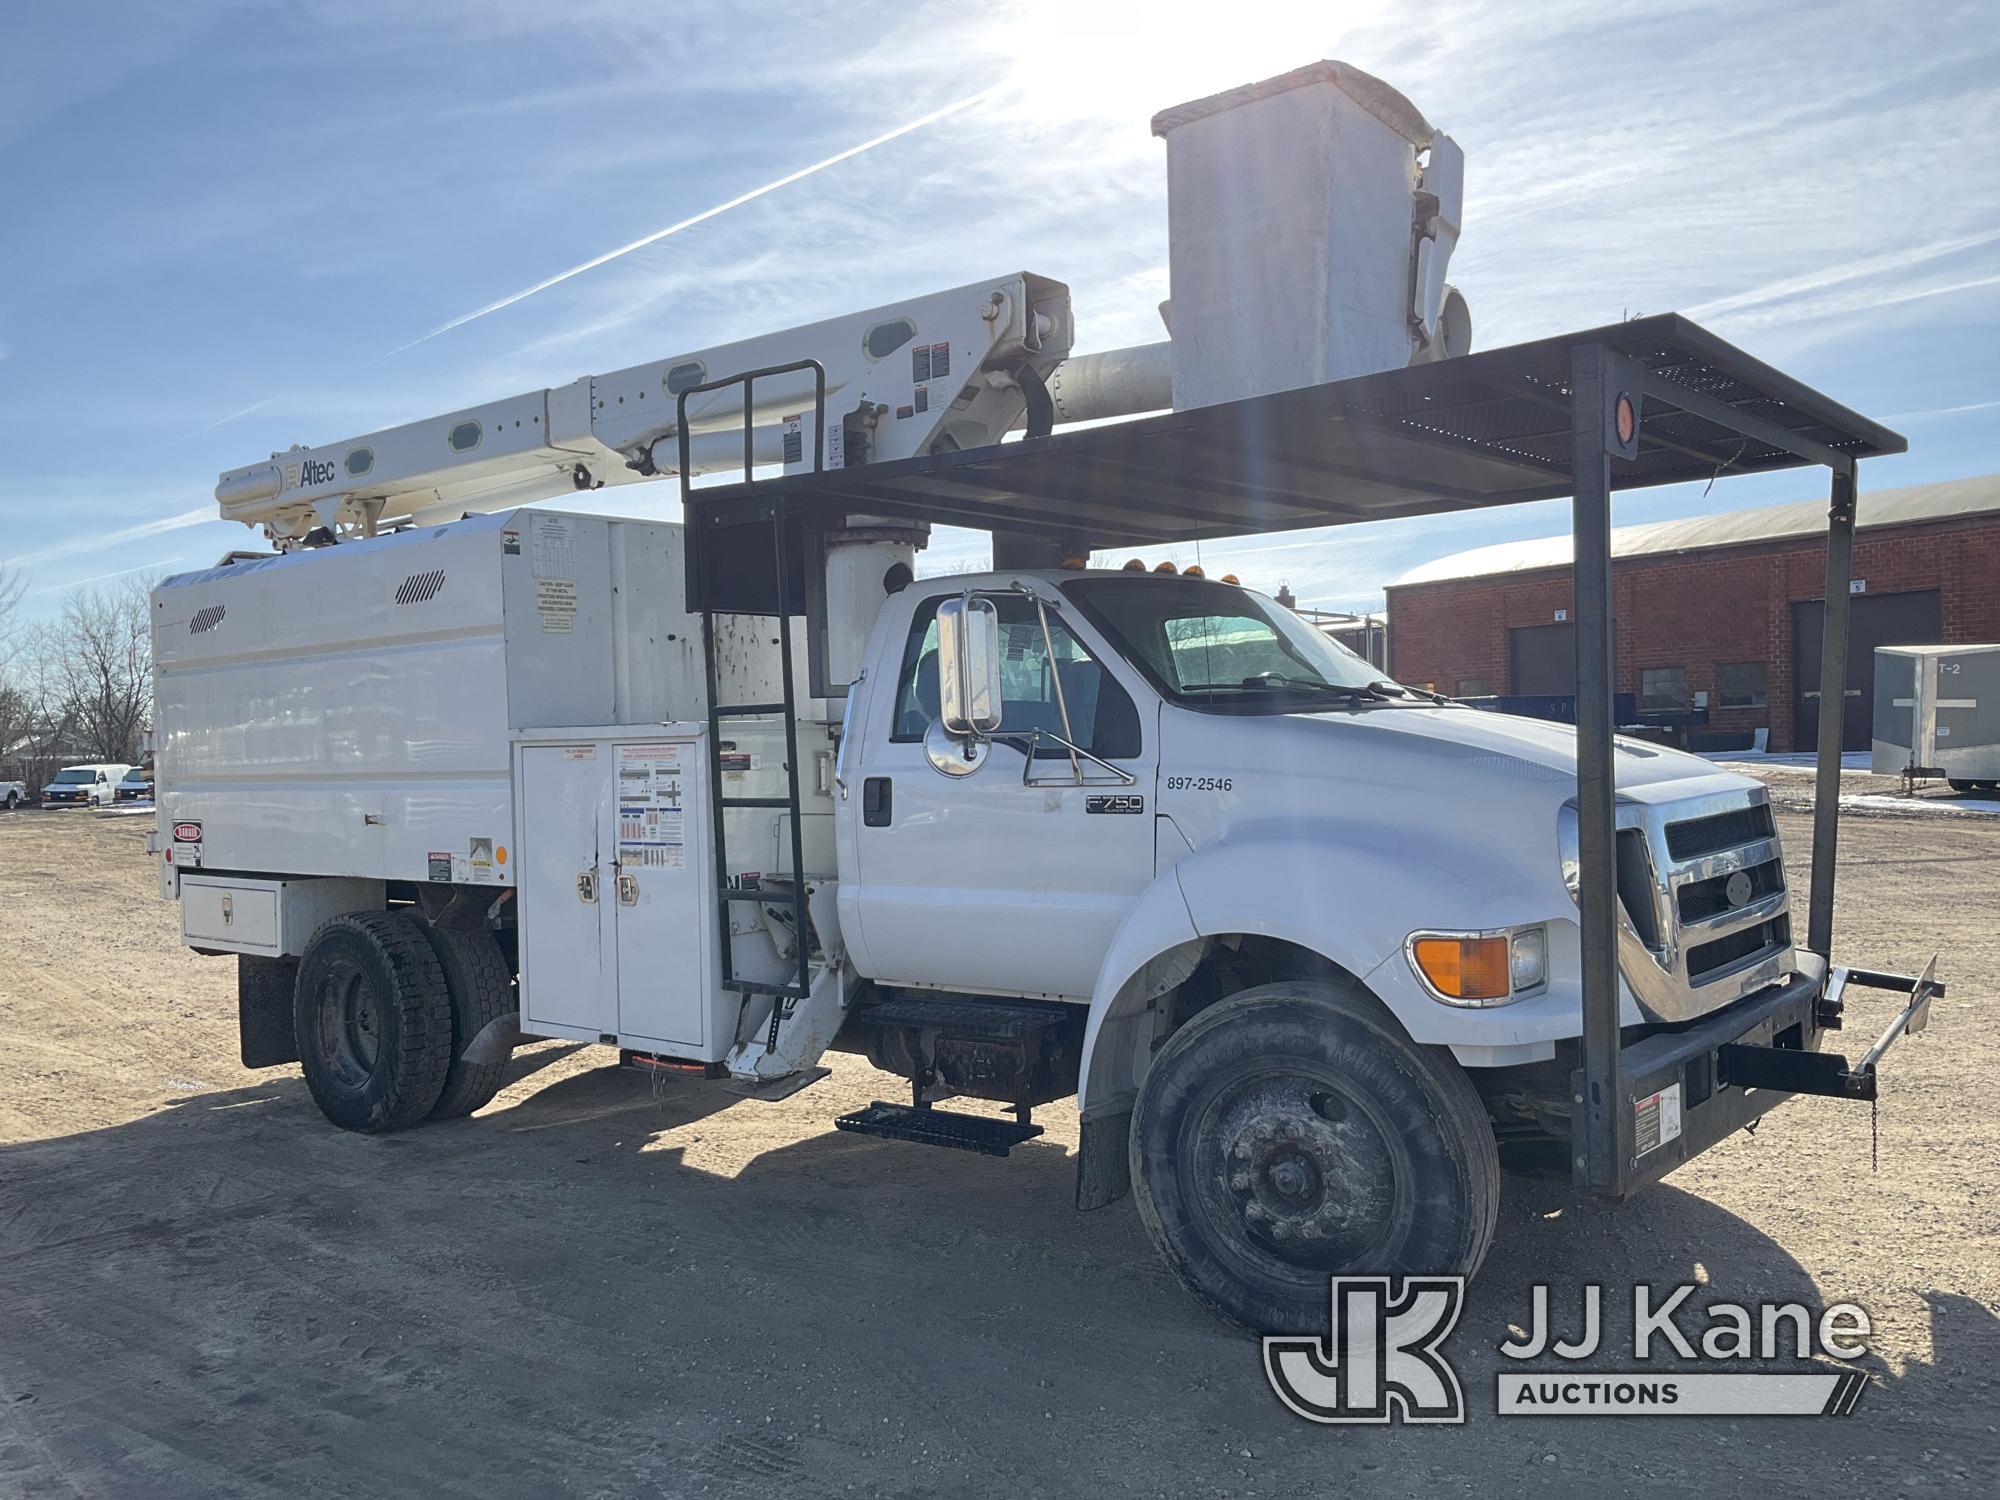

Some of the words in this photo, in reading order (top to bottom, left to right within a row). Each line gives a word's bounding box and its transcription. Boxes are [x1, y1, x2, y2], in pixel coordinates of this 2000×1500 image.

[301, 460, 335, 488] Altec
[1938, 663, 1961, 674] T-2
[1167, 777, 1232, 791] 897-2546
[178, 827, 198, 837] DANGER
